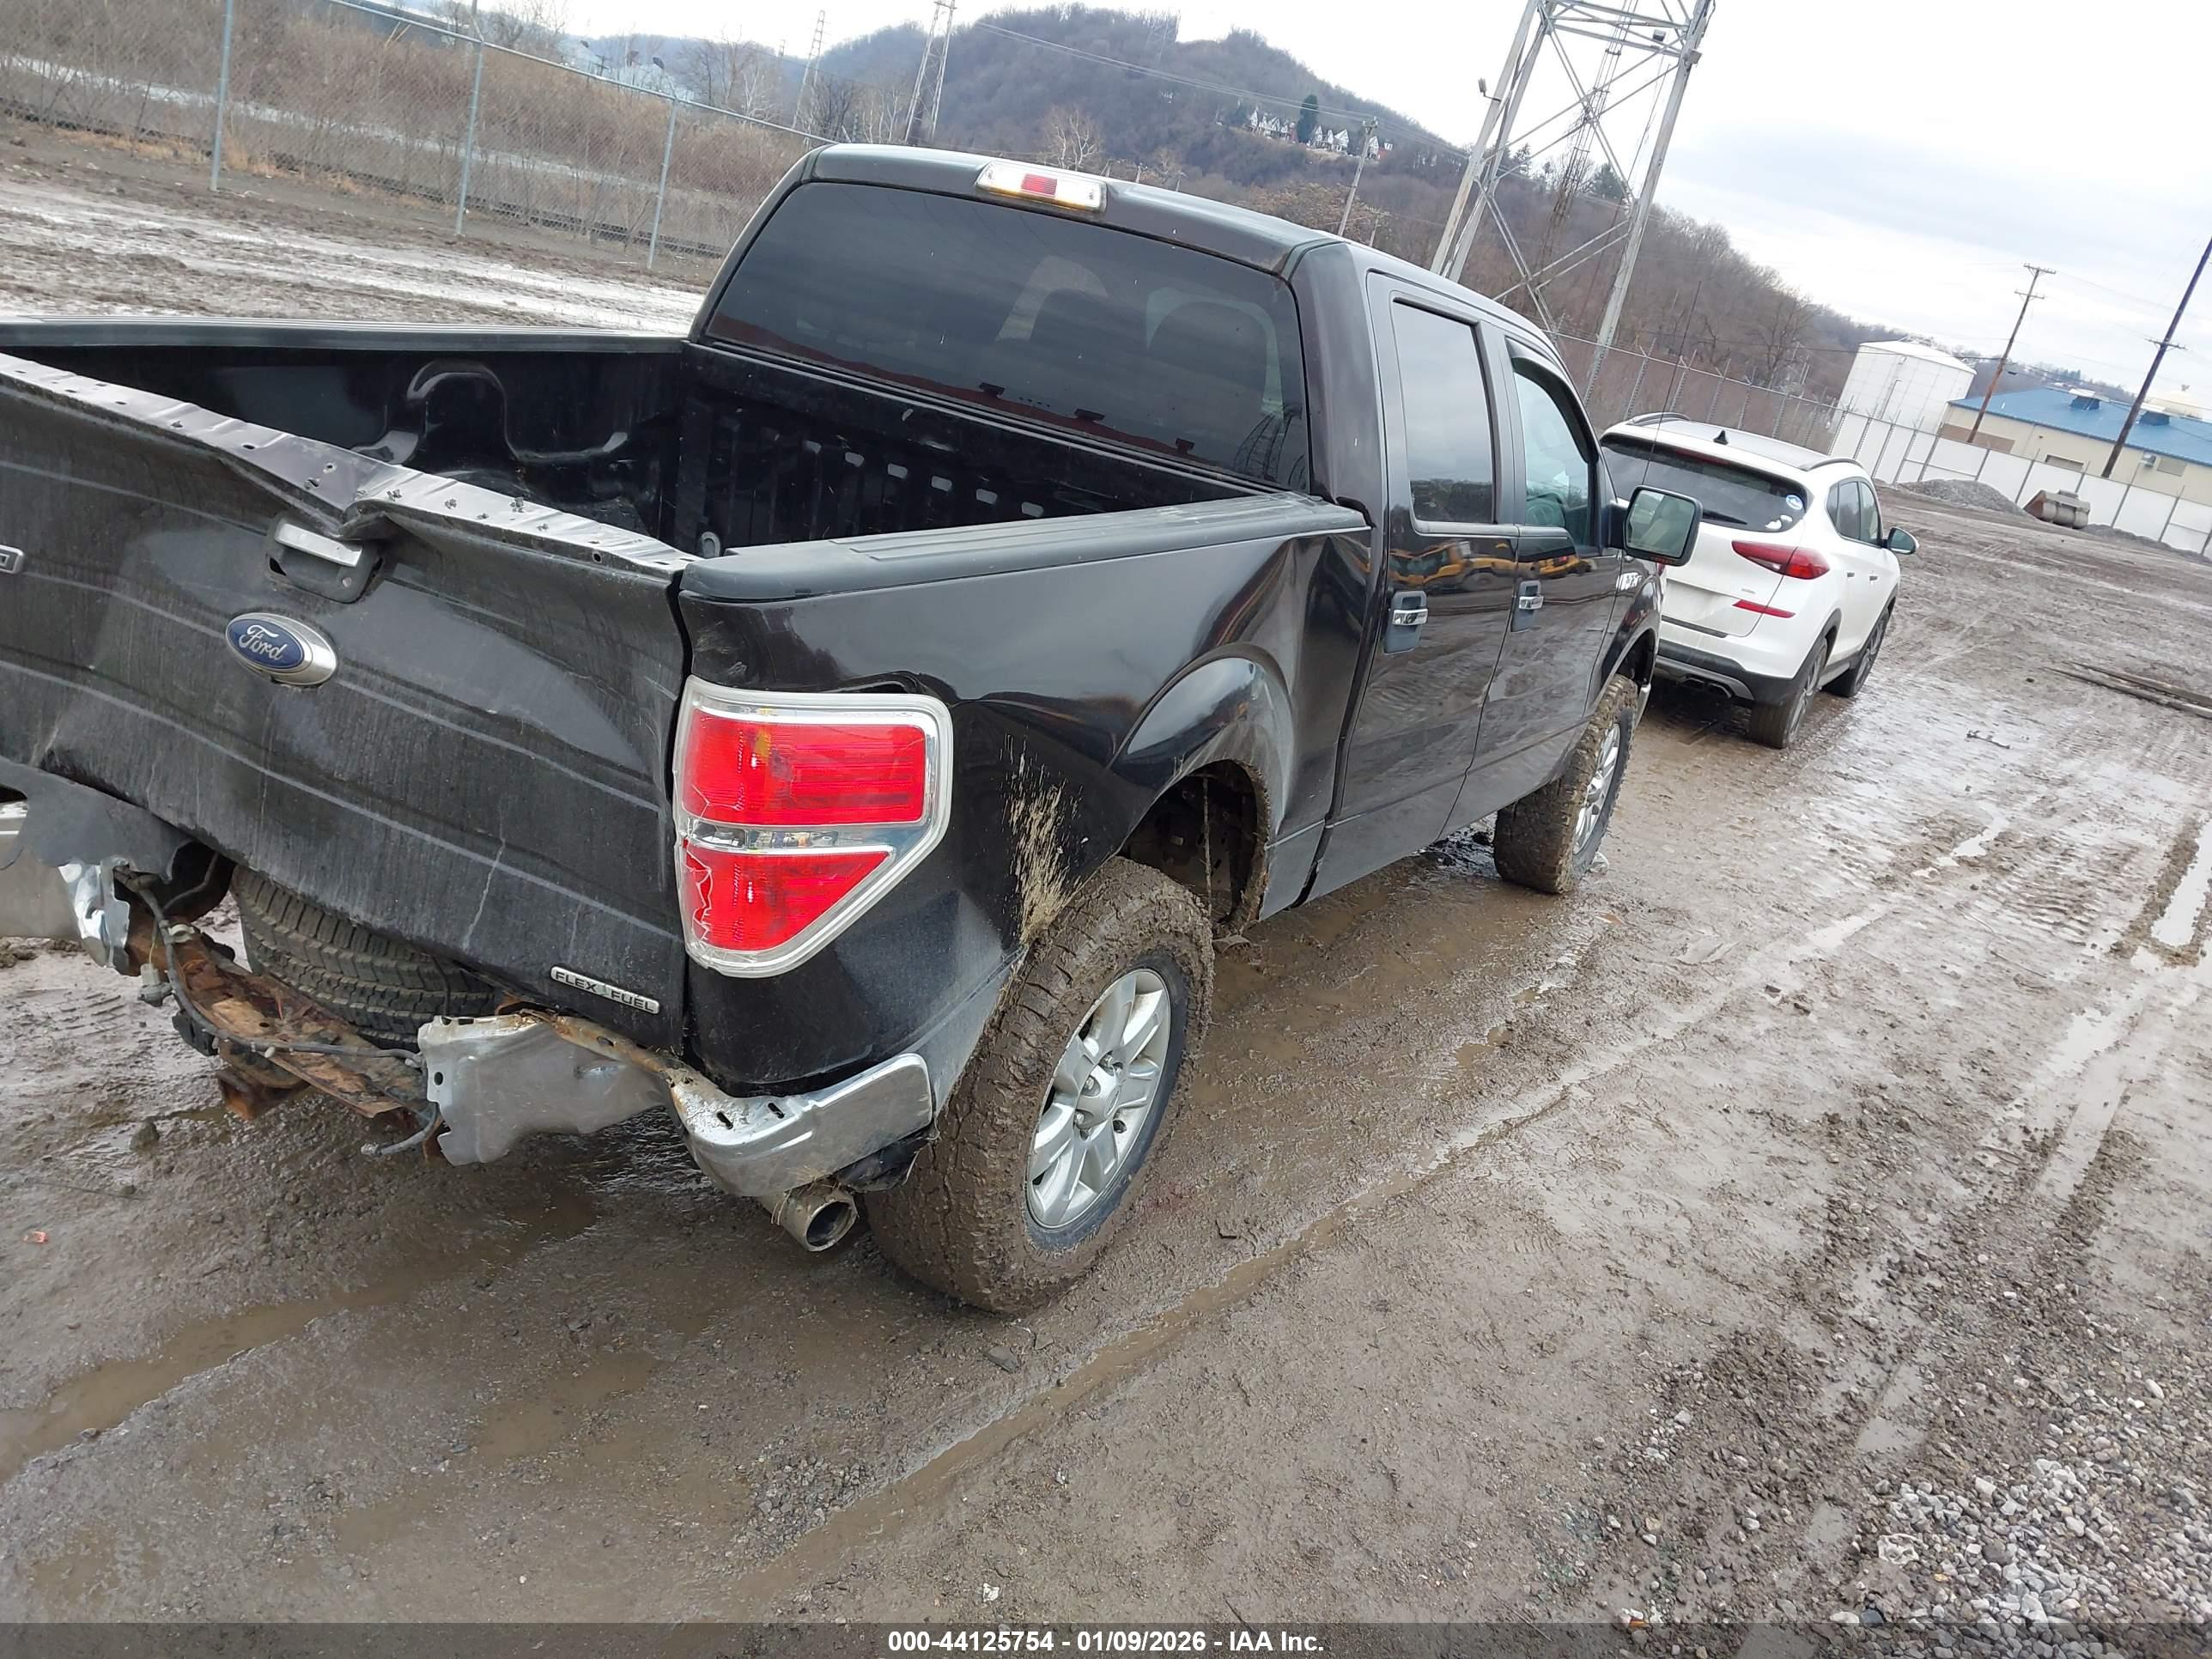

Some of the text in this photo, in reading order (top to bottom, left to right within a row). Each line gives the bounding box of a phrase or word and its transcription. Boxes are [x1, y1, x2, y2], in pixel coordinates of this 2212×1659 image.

[239, 624, 289, 660] Ford
[555, 971, 654, 1012] FLEX FUEL
